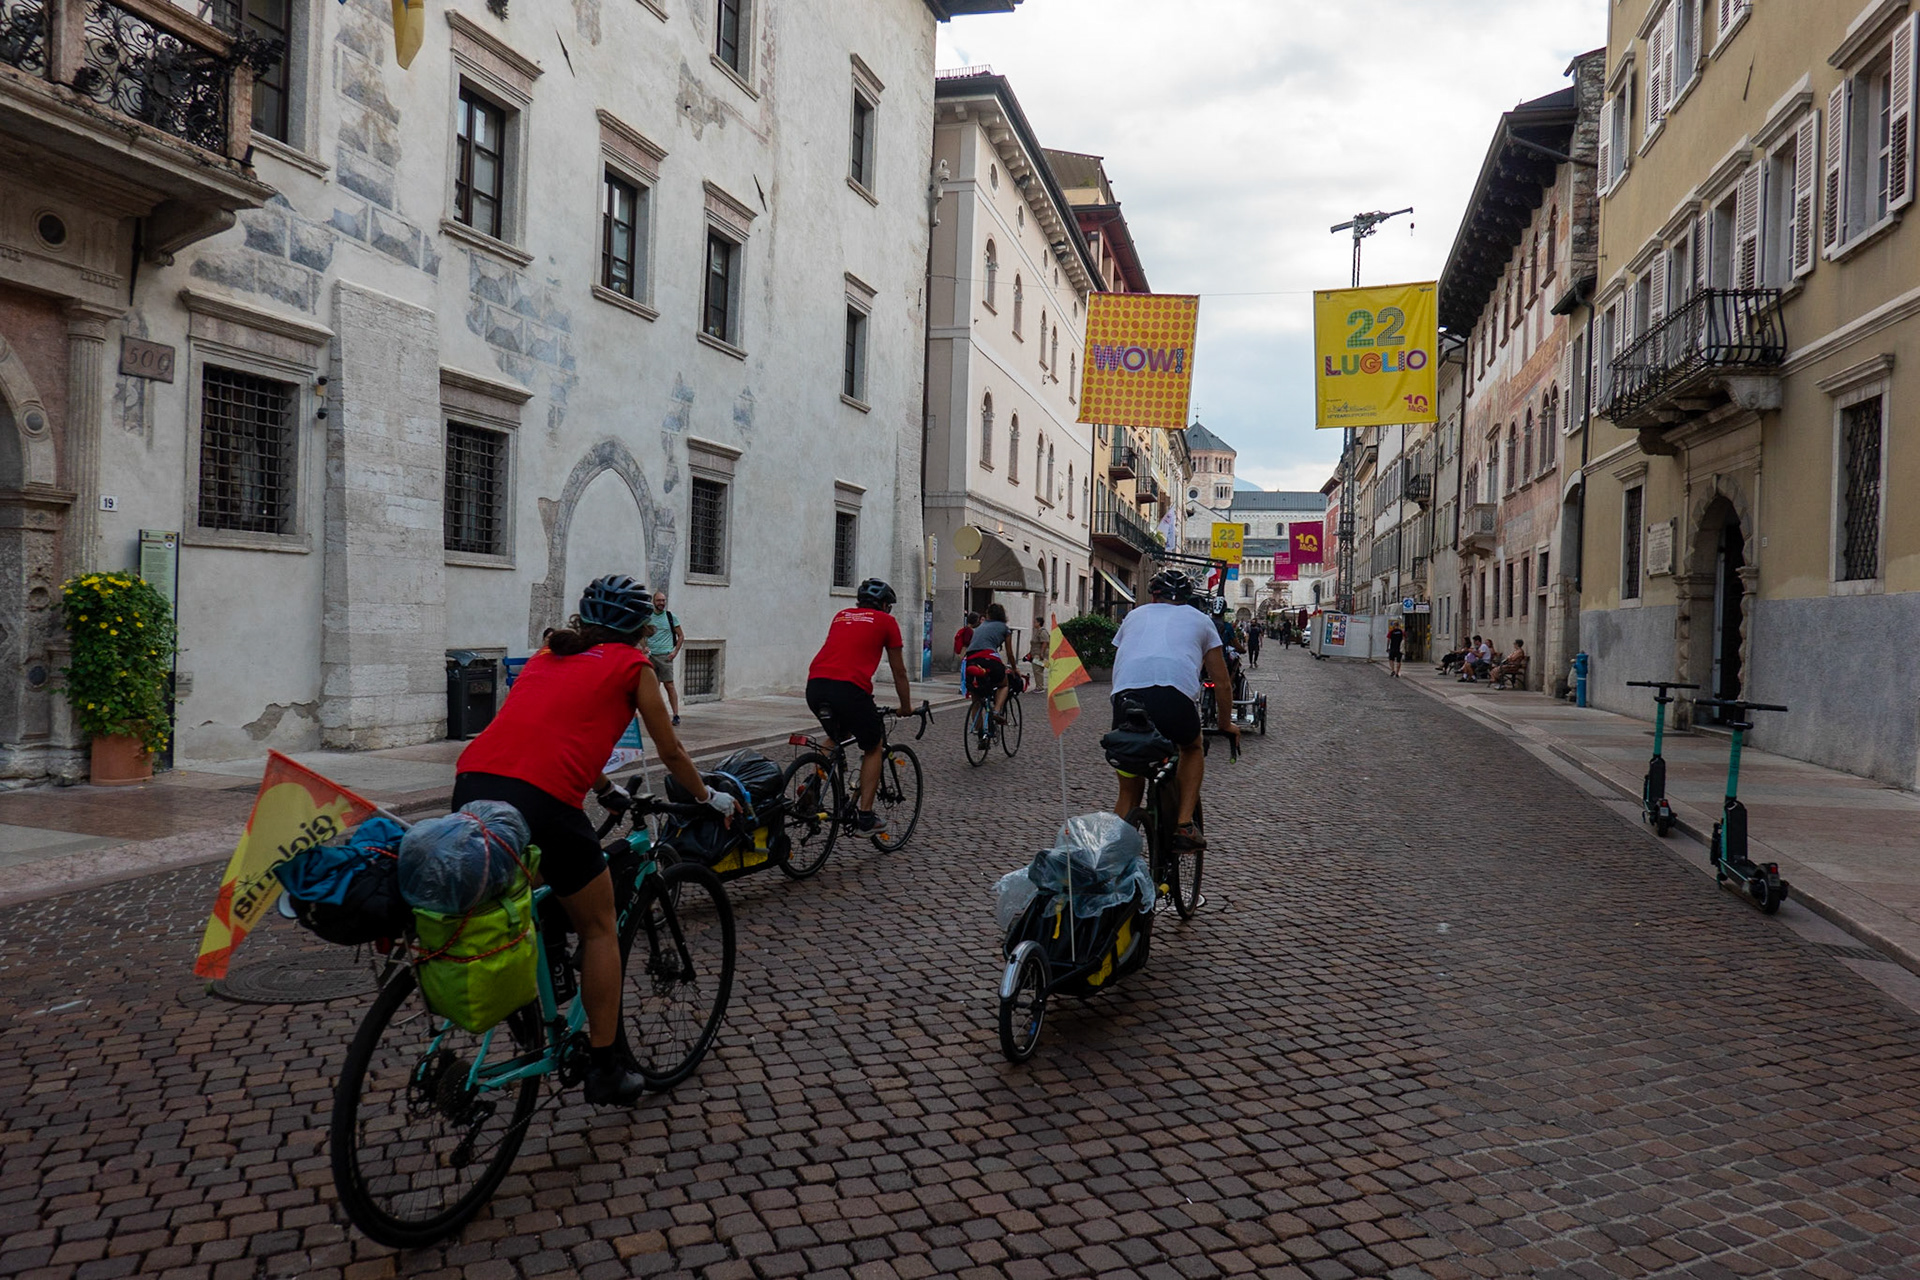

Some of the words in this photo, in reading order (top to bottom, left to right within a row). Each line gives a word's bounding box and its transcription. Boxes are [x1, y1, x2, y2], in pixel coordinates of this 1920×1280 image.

[1346, 306, 1405, 348] 22
[126, 347, 171, 376] 509
[1093, 344, 1184, 373] WOW!
[1325, 349, 1427, 376] LUGLIO
[1403, 394, 1428, 406] 10
[104, 497, 114, 509] 19
[1219, 529, 1235, 540] 22
[1295, 533, 1318, 546] 10
